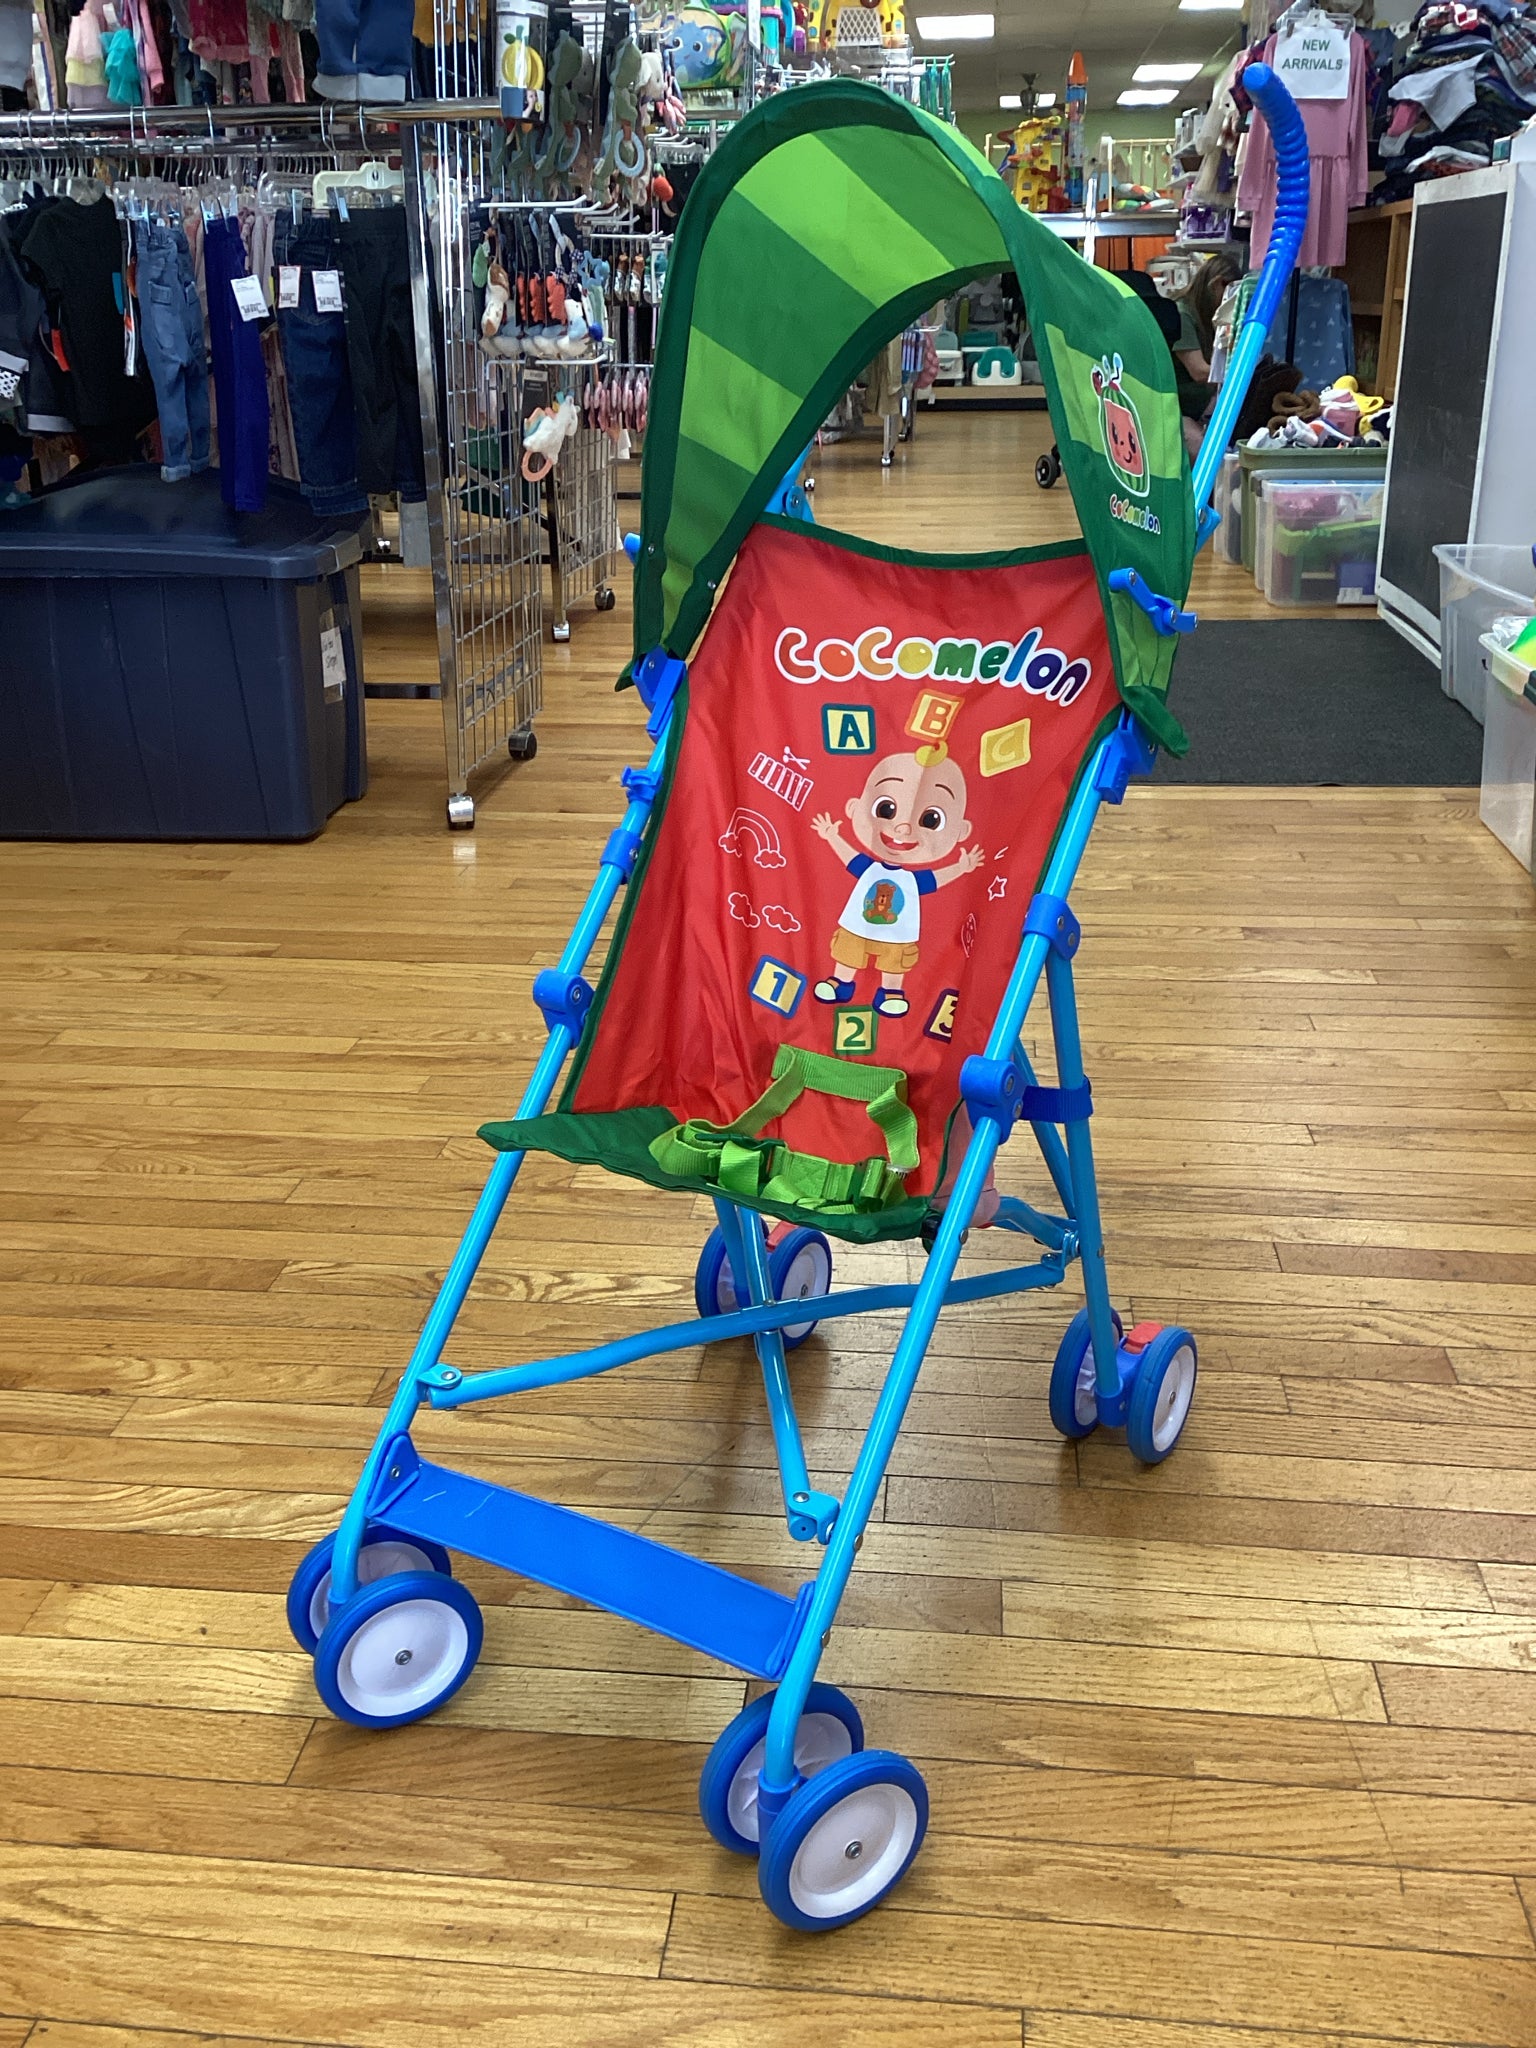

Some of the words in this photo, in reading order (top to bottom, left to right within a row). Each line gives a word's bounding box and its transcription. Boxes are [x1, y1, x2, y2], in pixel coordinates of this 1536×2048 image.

[1282, 58, 1343, 70] ARRIVALS
[1302, 39, 1330, 51] NEW
[838, 713, 865, 748] A
[920, 699, 952, 735] B
[992, 730, 1016, 763] C
[770, 971, 788, 1003] 1
[843, 1016, 866, 1048] 2
